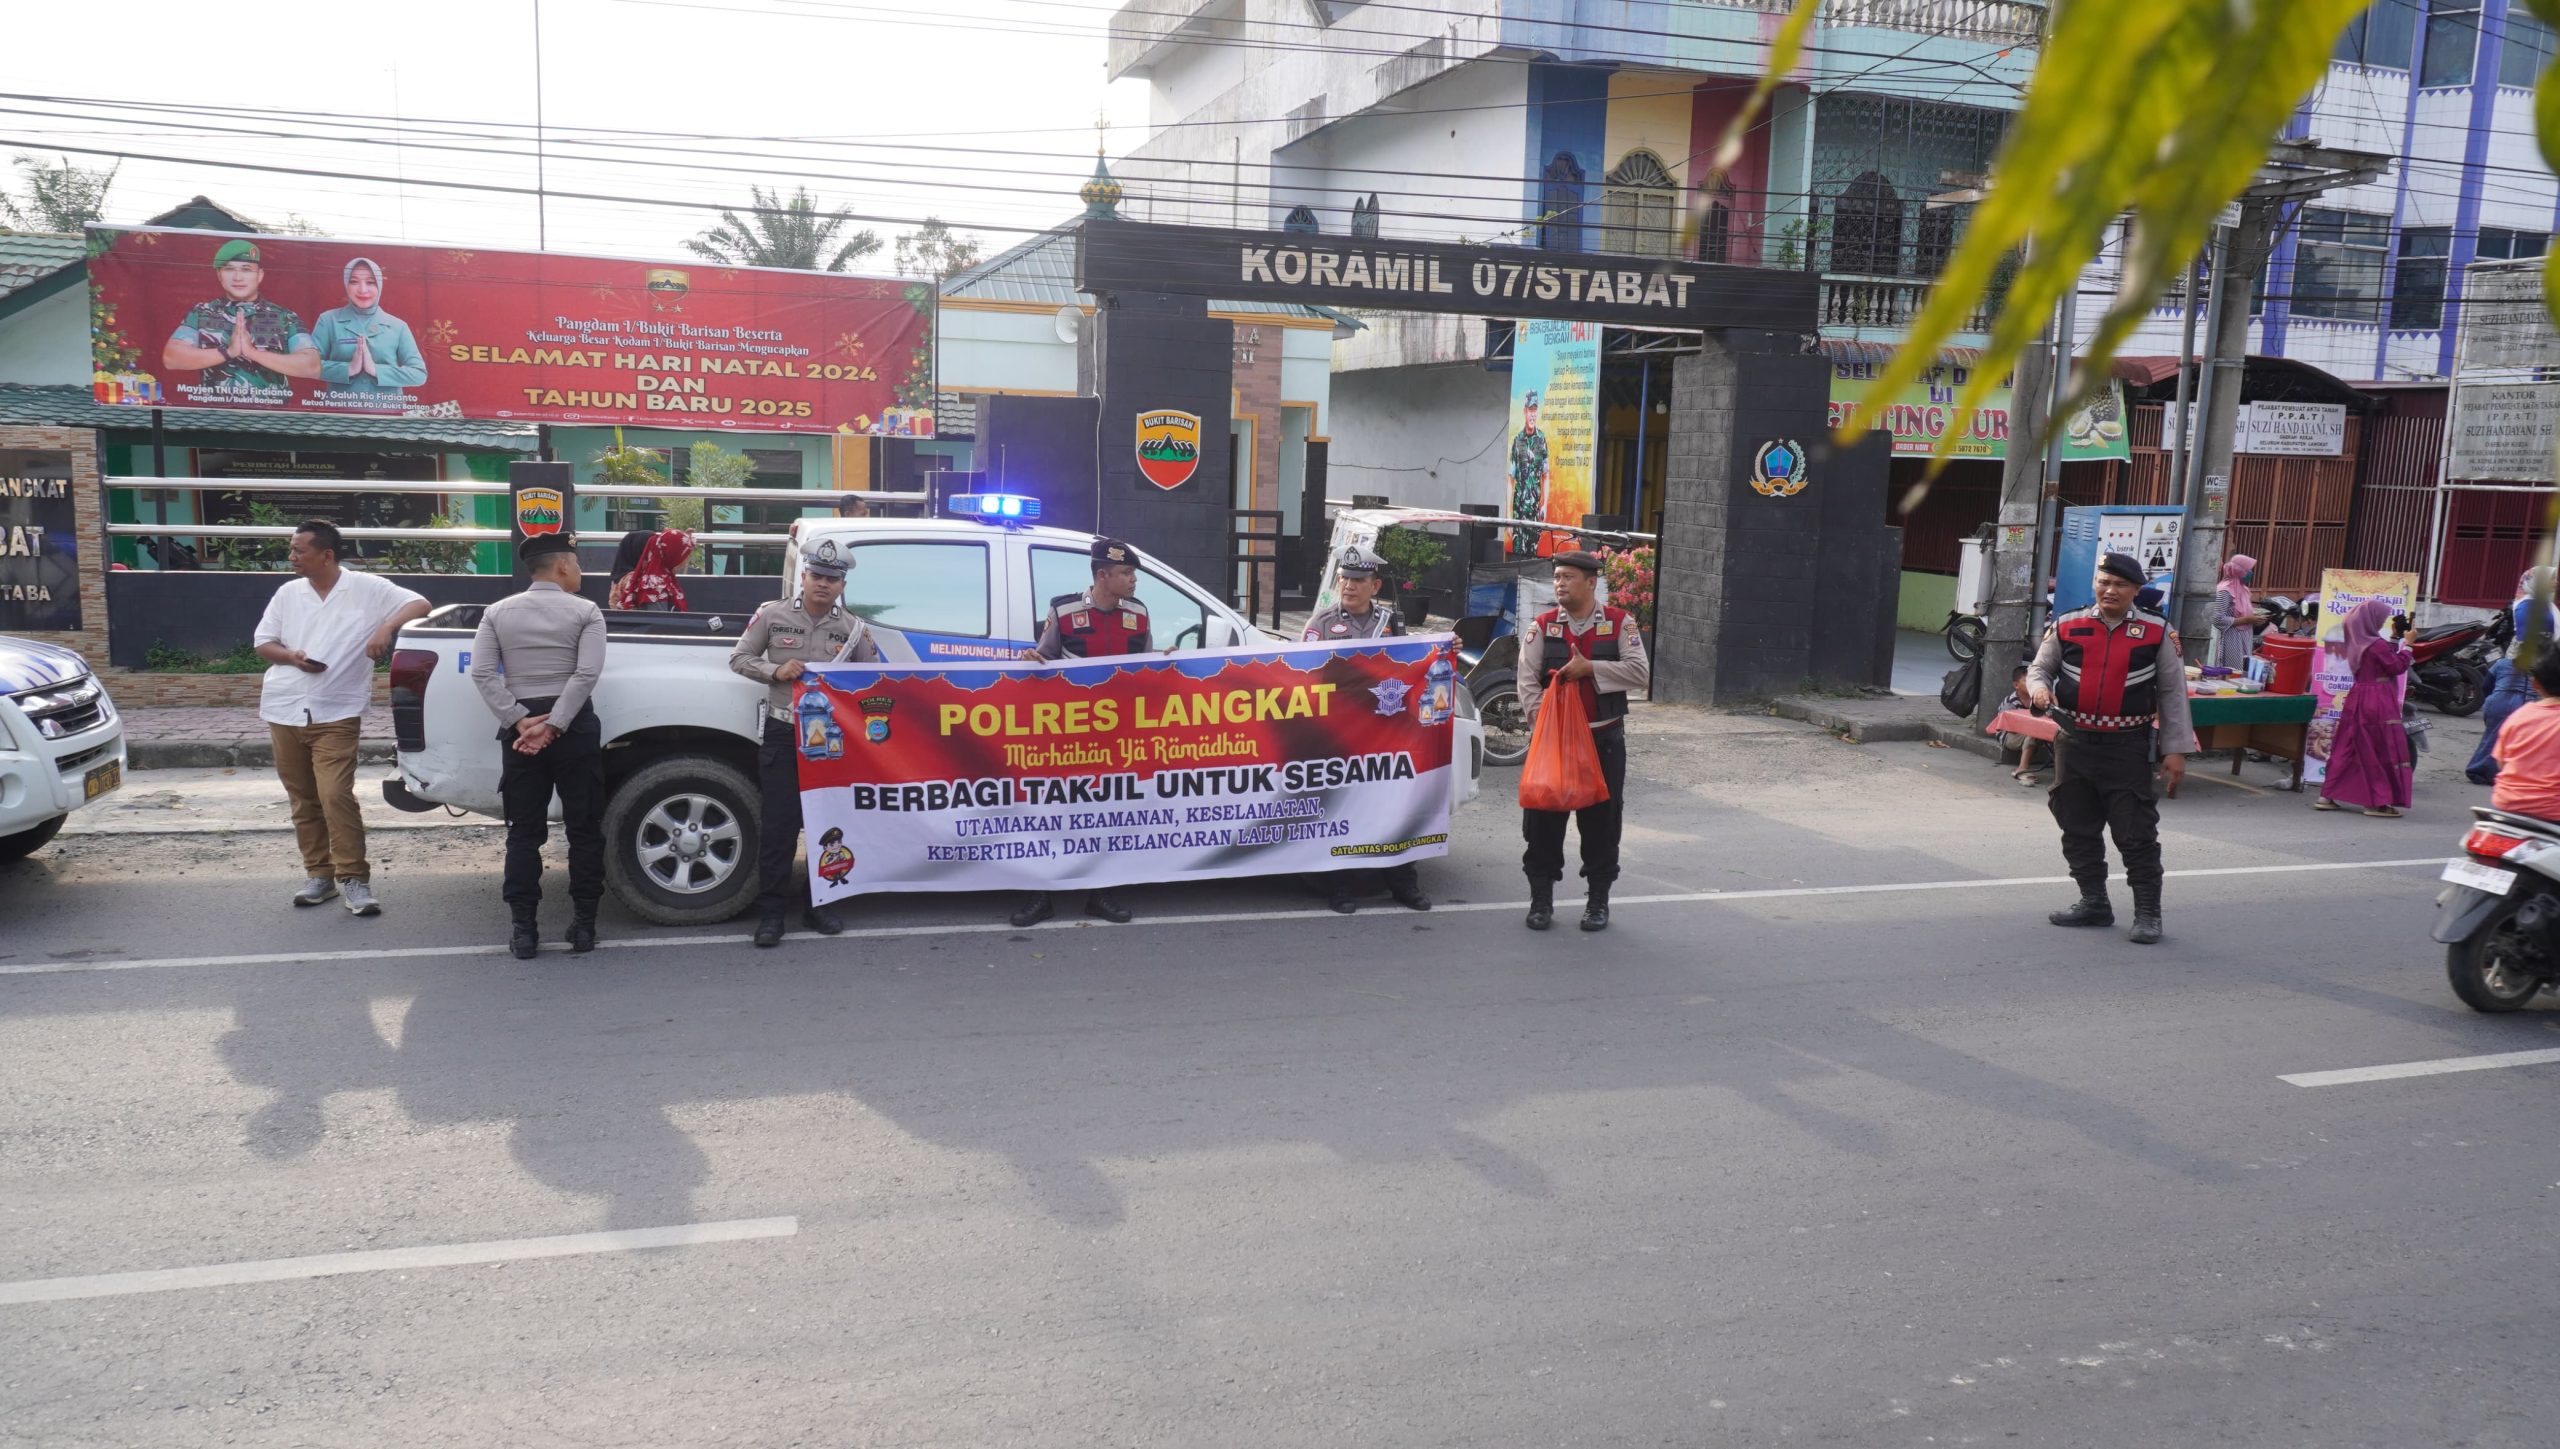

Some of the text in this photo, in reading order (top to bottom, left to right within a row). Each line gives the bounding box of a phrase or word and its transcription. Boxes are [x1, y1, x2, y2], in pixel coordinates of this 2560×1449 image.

[1241, 243, 1696, 308] KORAMIL 07/STABAT
[555, 316, 783, 341] Pangdam I/Bukit Barisan Beserta
[526, 329, 809, 356] Keluarga Besar Kodam I/Bukit Barisan Mengucapkan
[450, 344, 878, 383] SELAMAT HARI NATAL 2024
[177, 383, 294, 397] Mayjen TNI Rio Firdianto
[636, 375, 706, 394] DAN
[187, 394, 283, 405] Pangdam I/Bukit Barisan
[313, 390, 418, 402] Ny. Galuh Rio Firdianto
[523, 388, 812, 418] TAHUN BARU 2025
[2492, 391, 2536, 400] KANTOR
[301, 399, 323, 407] Ketua
[324, 400, 346, 408] Persit
[402, 403, 429, 411] Barisan
[1144, 416, 1194, 430] BUKIT BARISAN
[2251, 421, 2271, 433] SUZI
[2330, 424, 2342, 435] SH
[2466, 426, 2484, 436] SUZI
[231, 461, 290, 469] PERINTAH
[2206, 476, 2219, 486] WC
[1, 584, 51, 601] TABA
[940, 683, 1337, 737] POLRES LANGKAT
[853, 753, 1415, 811] BERBAGI TAKJIL UNTUK SESAMA
[955, 798, 1325, 838] UTAMAKAN KEAMANAN, KESELAMATAN,
[927, 819, 1350, 861] KETERTIBAN, DAN KELANCARAN LALU LINTAS
[1331, 833, 1448, 857] SATLANTAS POLRES LANGKAT
